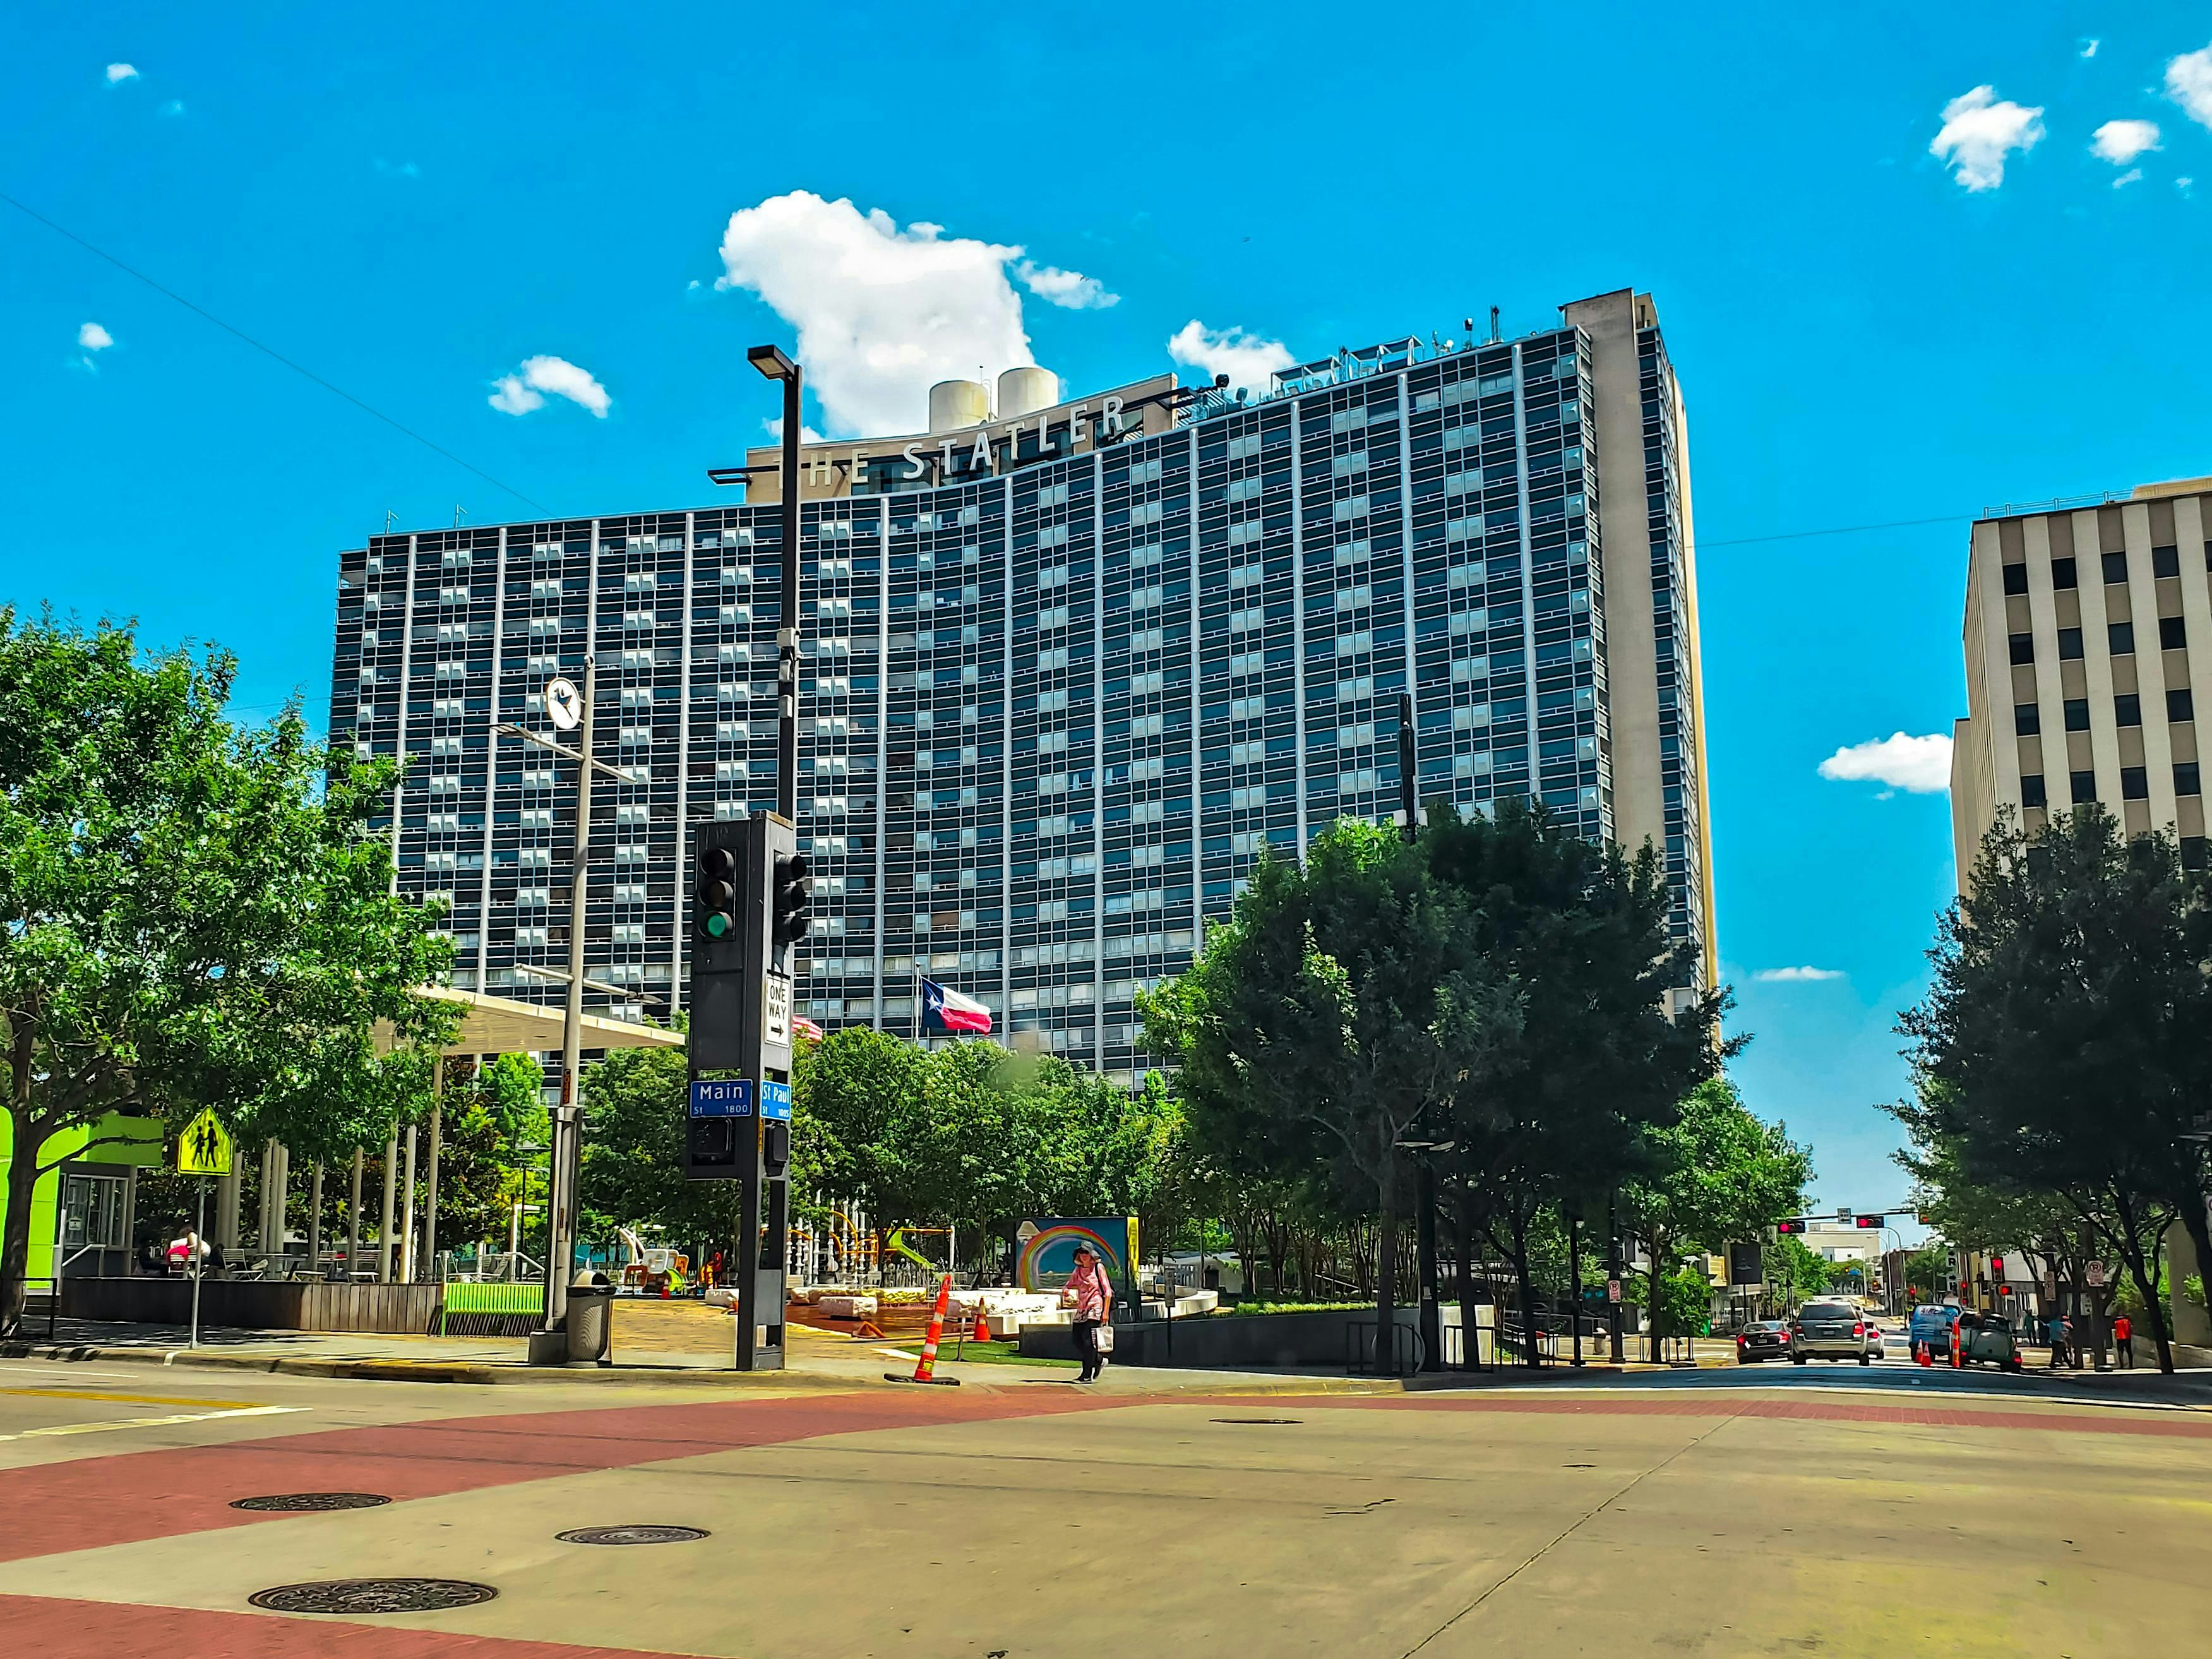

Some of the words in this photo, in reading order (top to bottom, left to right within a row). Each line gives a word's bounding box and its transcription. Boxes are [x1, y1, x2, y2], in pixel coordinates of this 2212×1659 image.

[903, 396, 1124, 479] STATLER
[770, 985, 786, 1003] ONE
[769, 1002, 787, 1020] WAY
[700, 1082, 743, 1100] Main
[763, 1084, 771, 1100] St
[774, 1086, 789, 1104] Paul
[693, 1106, 703, 1115] St
[725, 1105, 748, 1113] 1800
[762, 1105, 768, 1115] St
